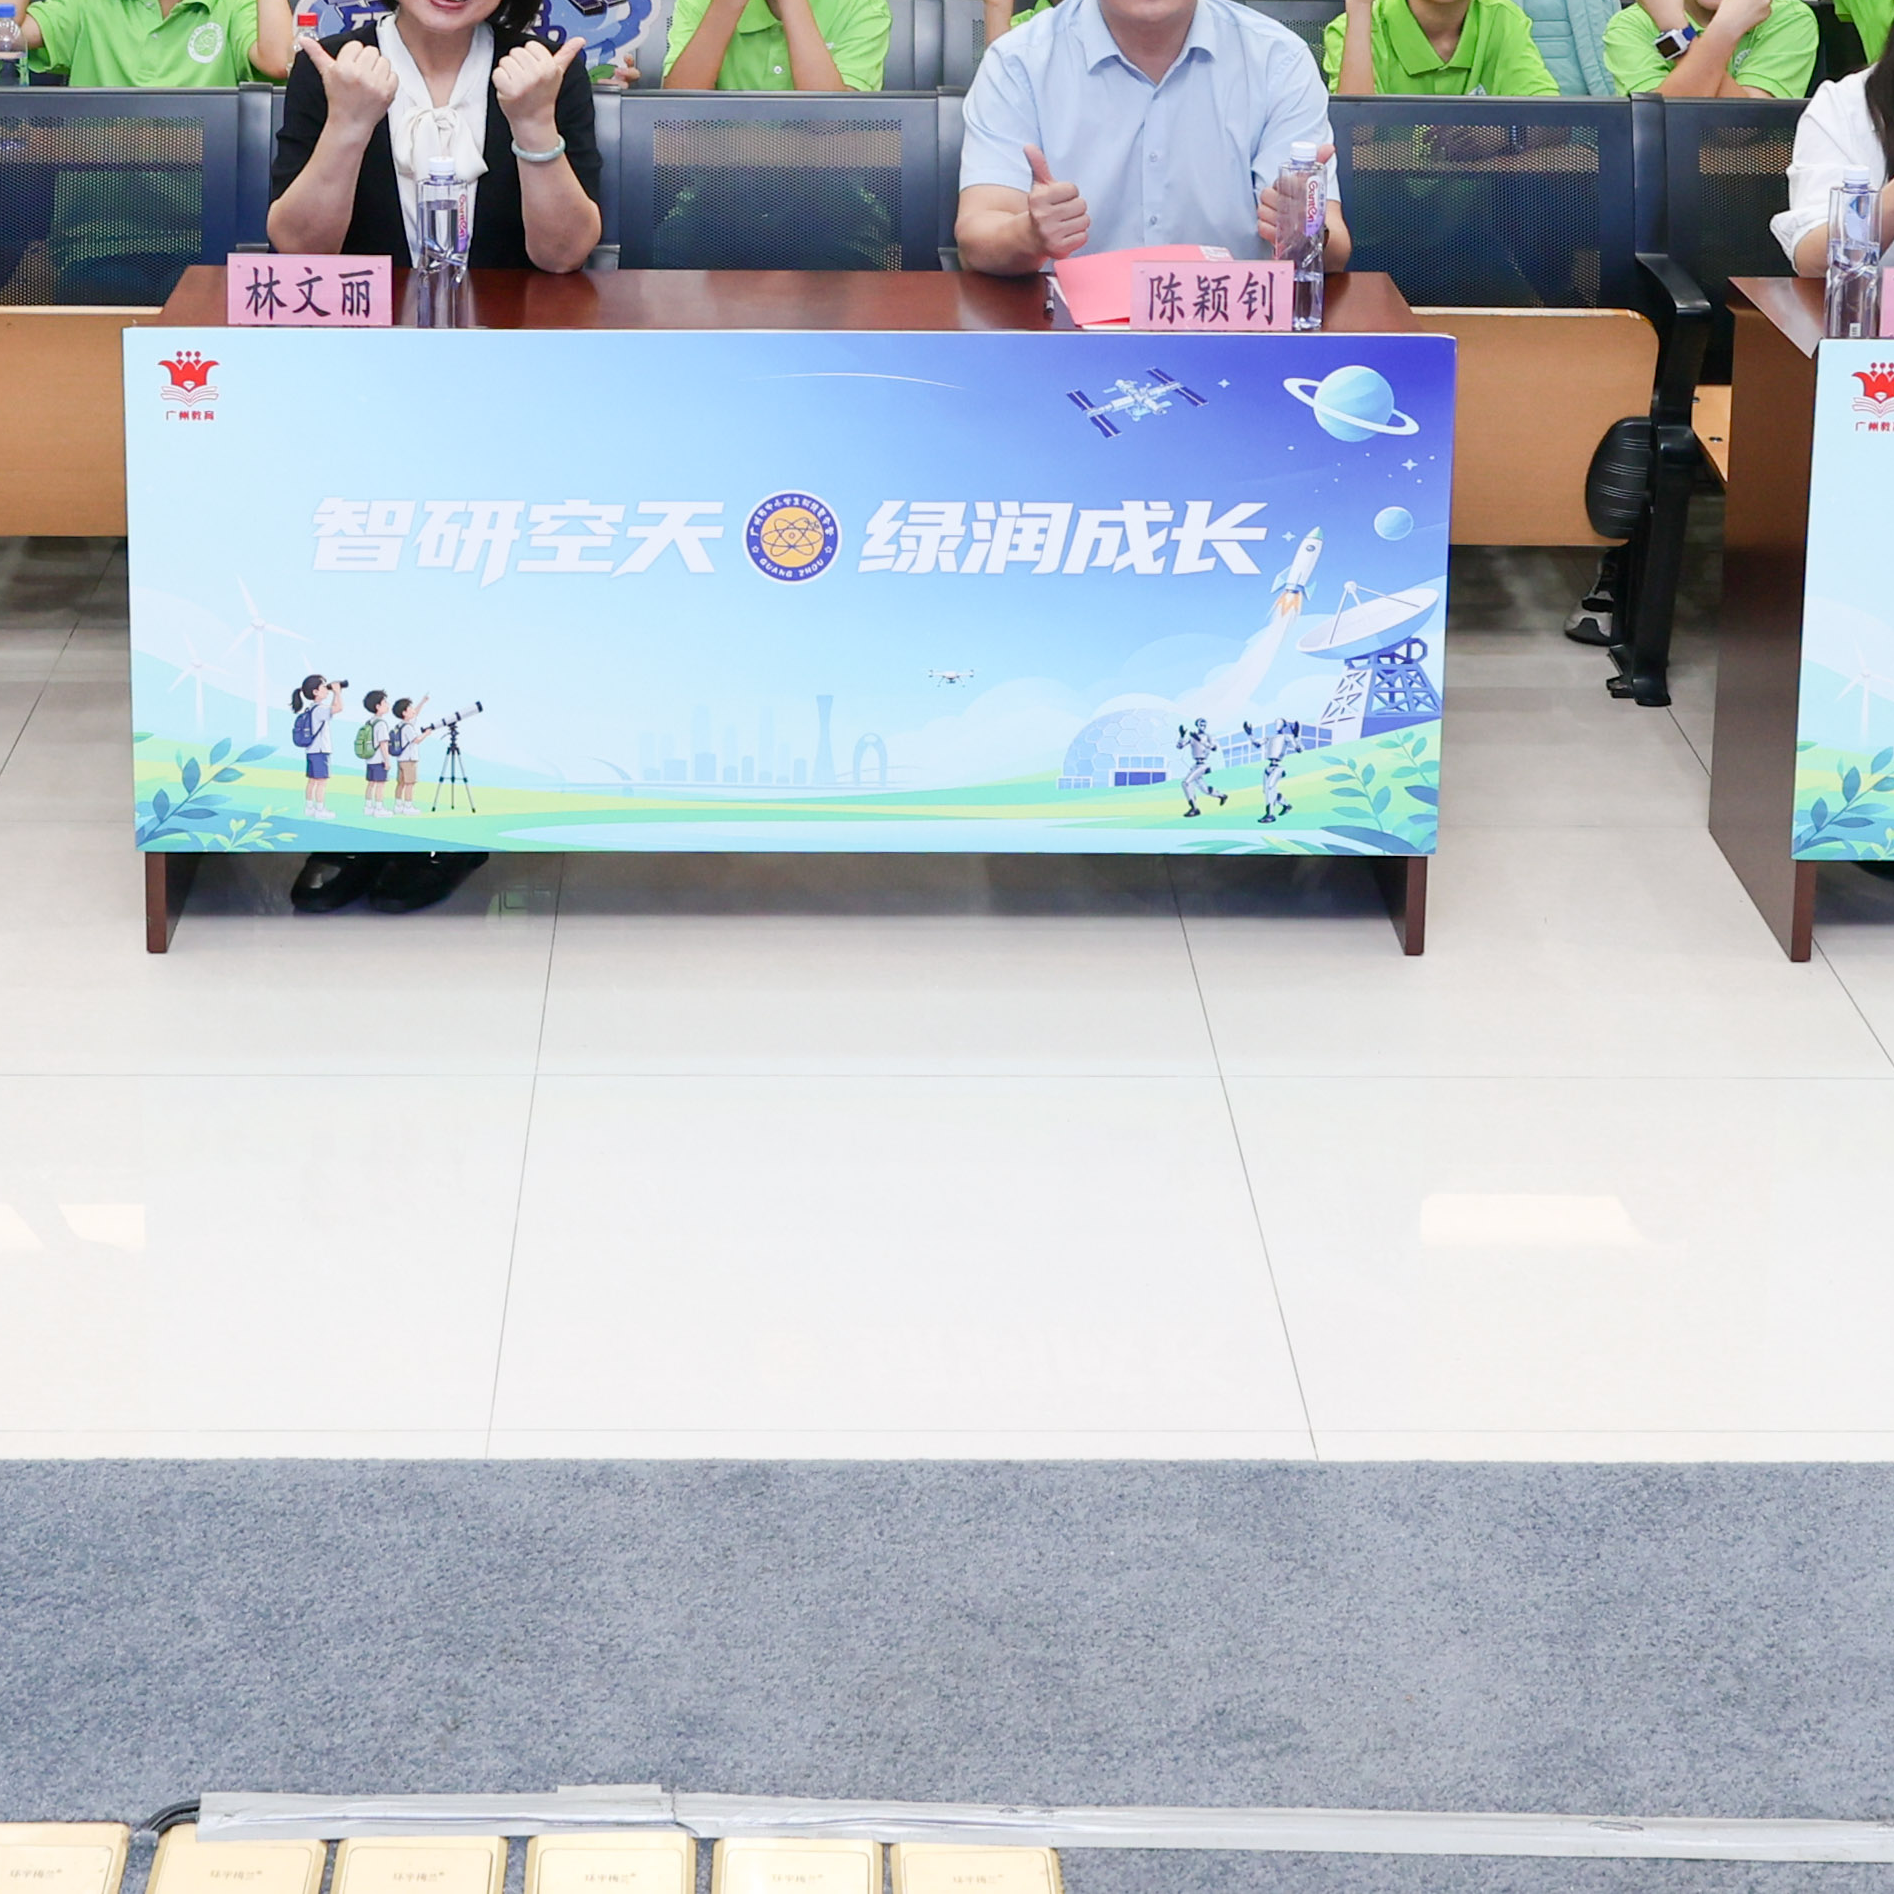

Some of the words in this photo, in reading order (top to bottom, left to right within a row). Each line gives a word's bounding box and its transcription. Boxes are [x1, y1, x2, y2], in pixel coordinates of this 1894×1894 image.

[245, 266, 374, 320] 林文丽
[1149, 271, 1274, 325] 陈颖钊
[310, 497, 725, 588] 智研空天
[857, 499, 1268, 577] 绿润成长
